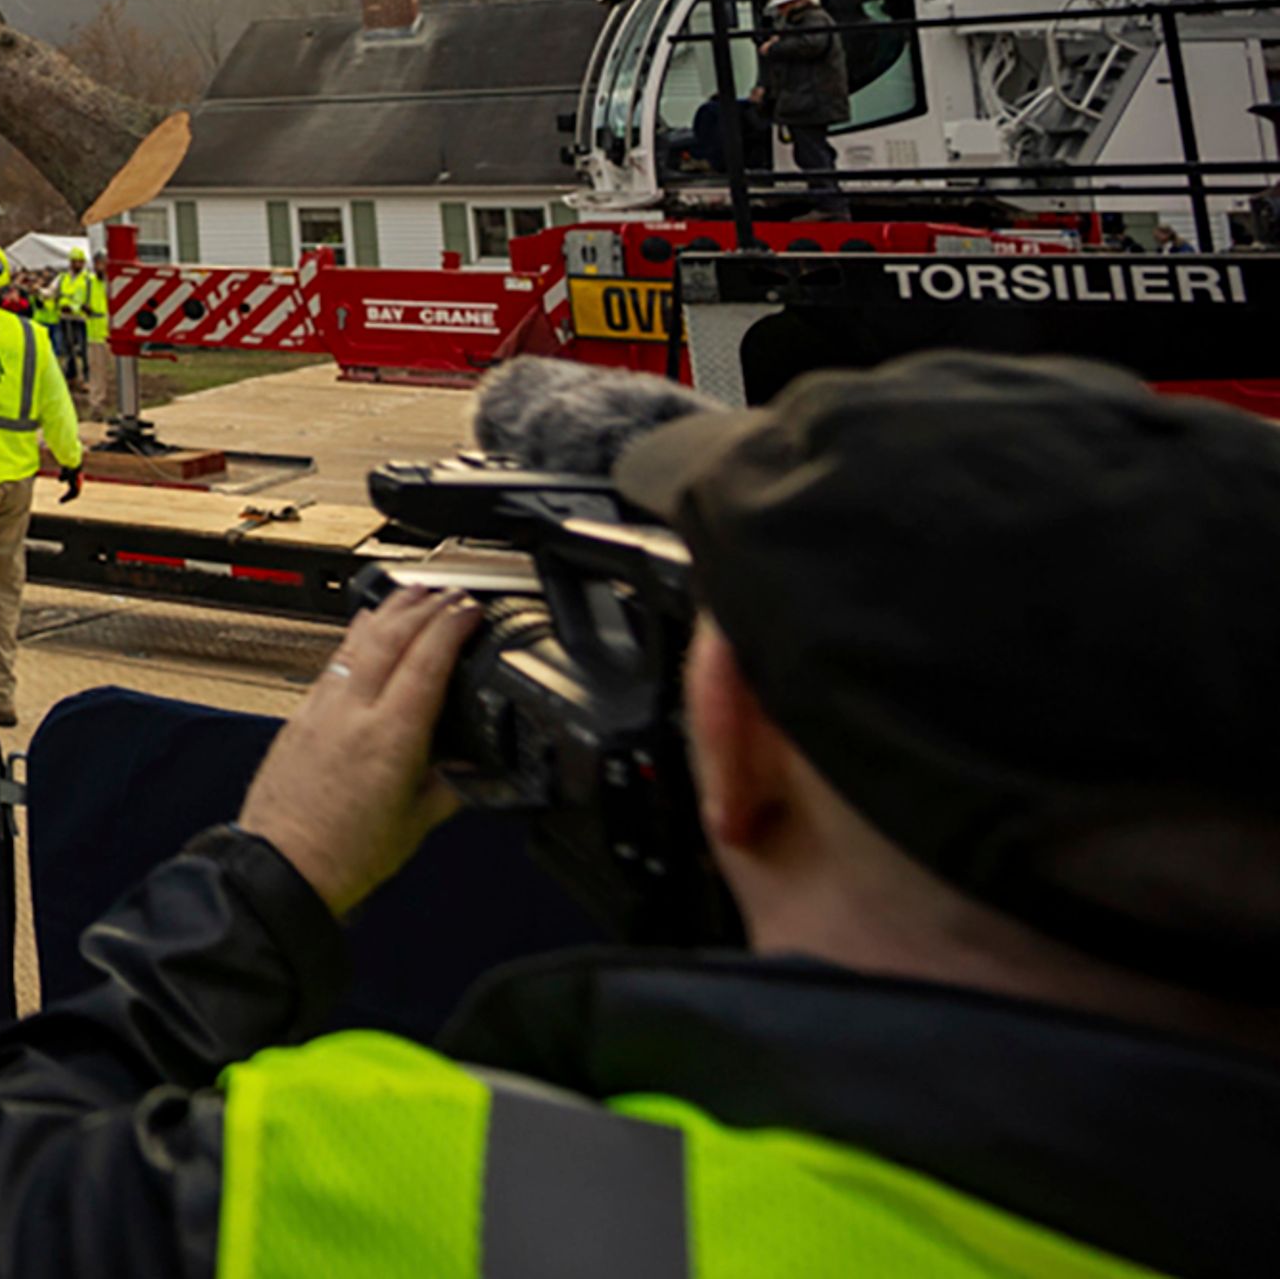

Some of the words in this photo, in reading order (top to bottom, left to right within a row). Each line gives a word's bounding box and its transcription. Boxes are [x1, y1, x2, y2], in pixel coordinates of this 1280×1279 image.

[883, 263, 1247, 303] TORSILIERI
[366, 306, 404, 322] BAY
[419, 308, 496, 326] CRANE
